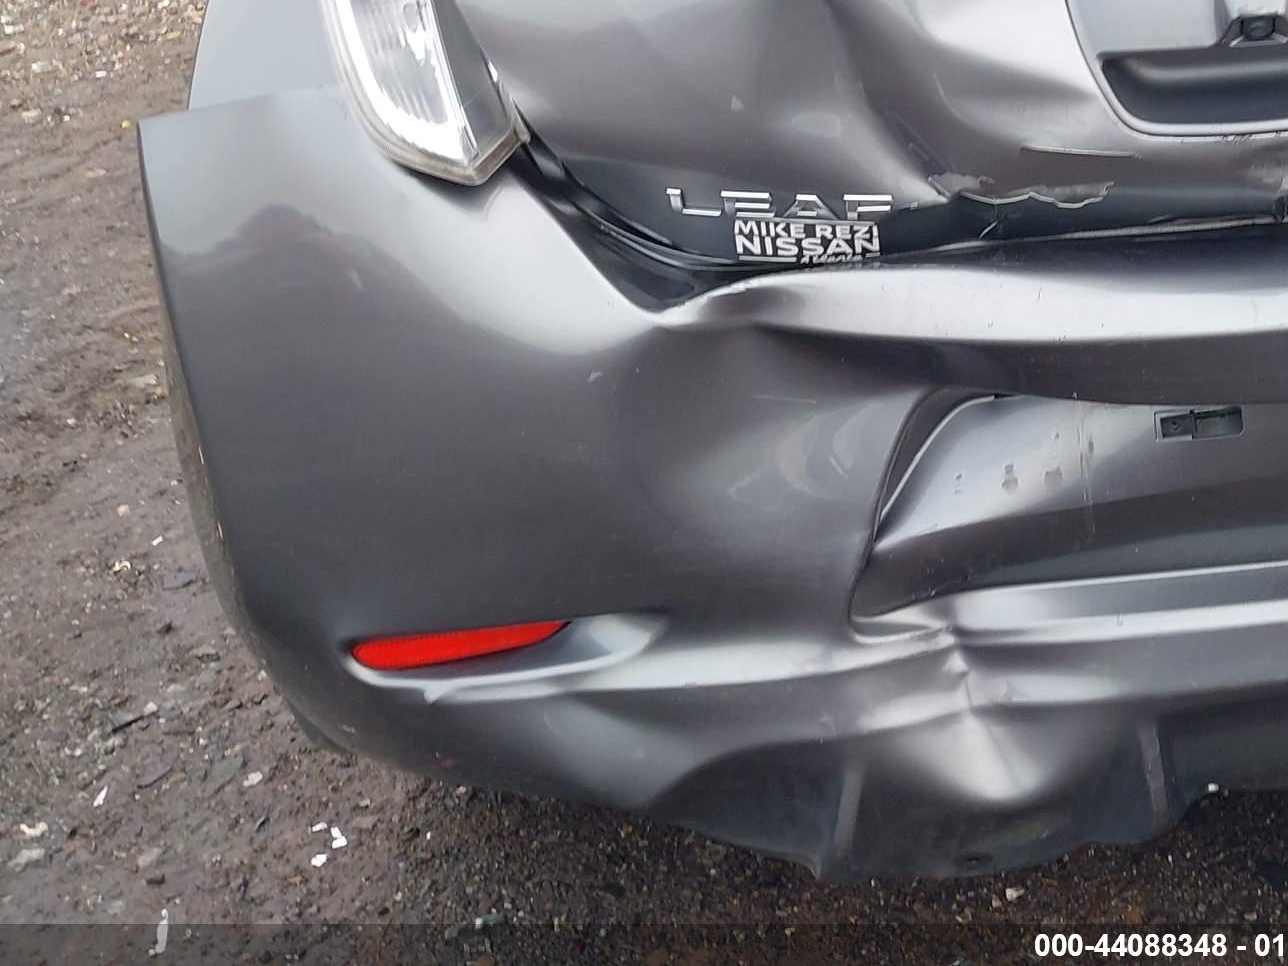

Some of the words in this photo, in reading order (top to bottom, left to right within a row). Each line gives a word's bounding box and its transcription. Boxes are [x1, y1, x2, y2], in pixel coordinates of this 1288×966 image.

[666, 187, 893, 220] LEAF
[734, 219, 805, 238] MIKE
[735, 234, 880, 256] NISSAN
